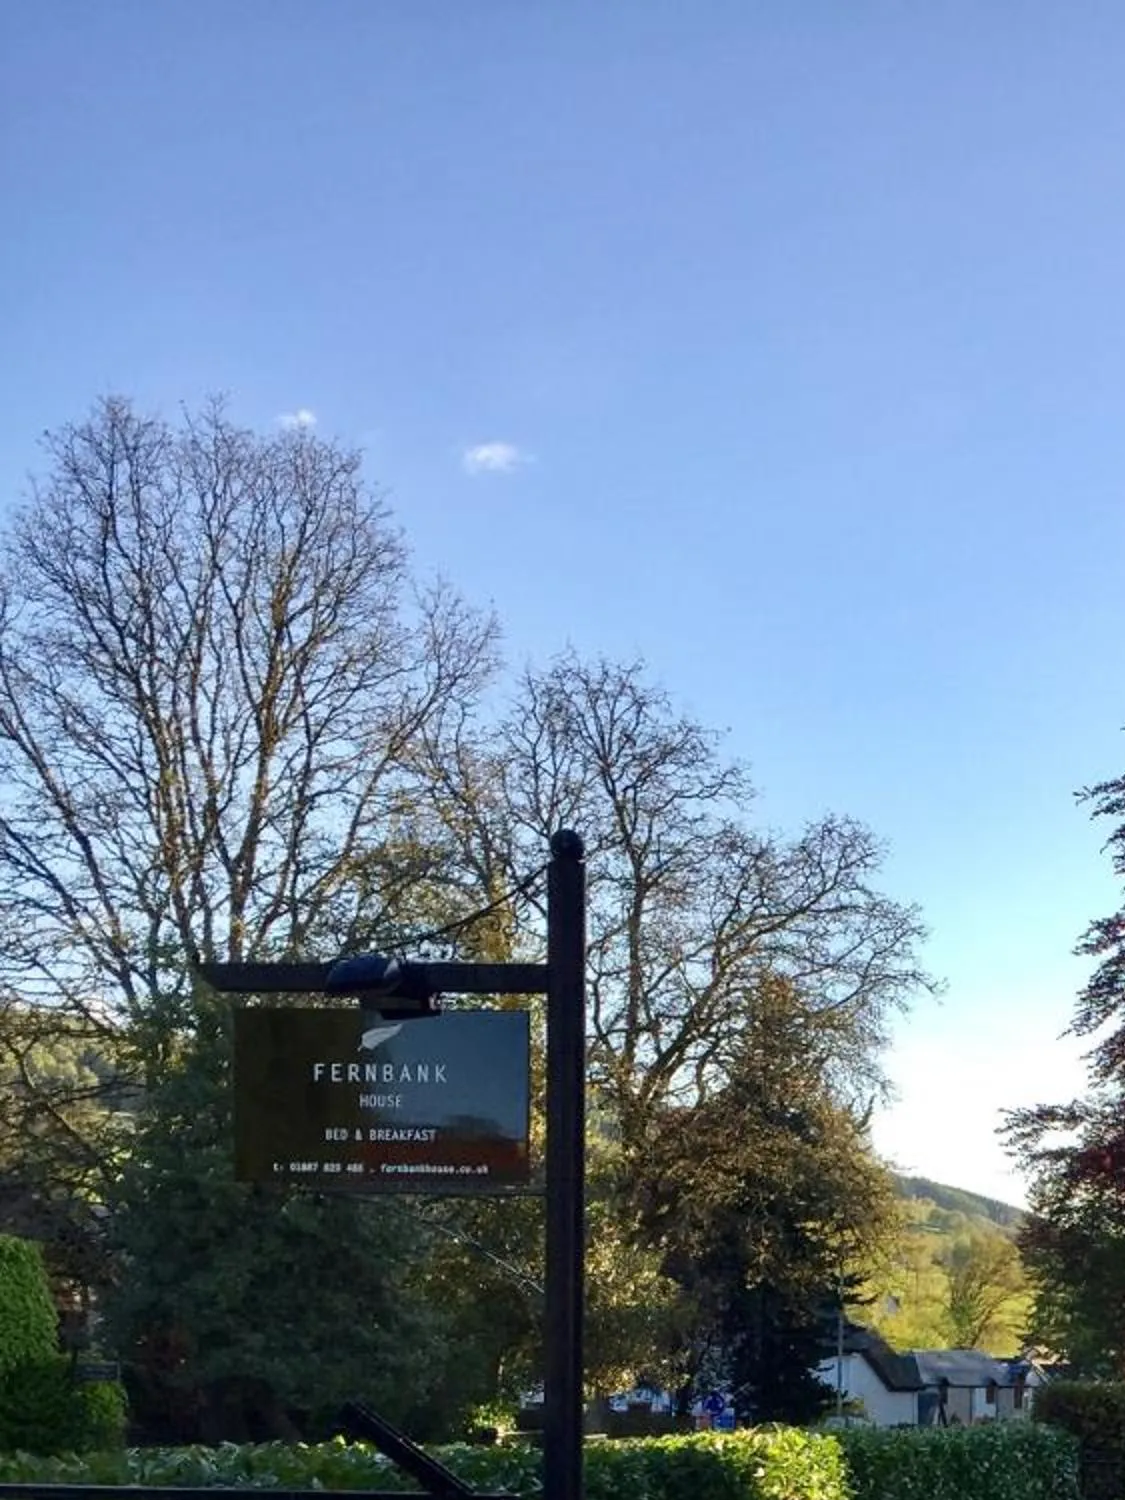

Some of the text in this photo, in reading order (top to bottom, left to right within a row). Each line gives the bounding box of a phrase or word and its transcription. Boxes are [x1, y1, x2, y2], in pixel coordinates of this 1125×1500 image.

[313, 1063, 448, 1083] FERNBANK
[358, 1094, 403, 1109] HOUSE
[325, 1128, 437, 1142] BED & BREAKFAST
